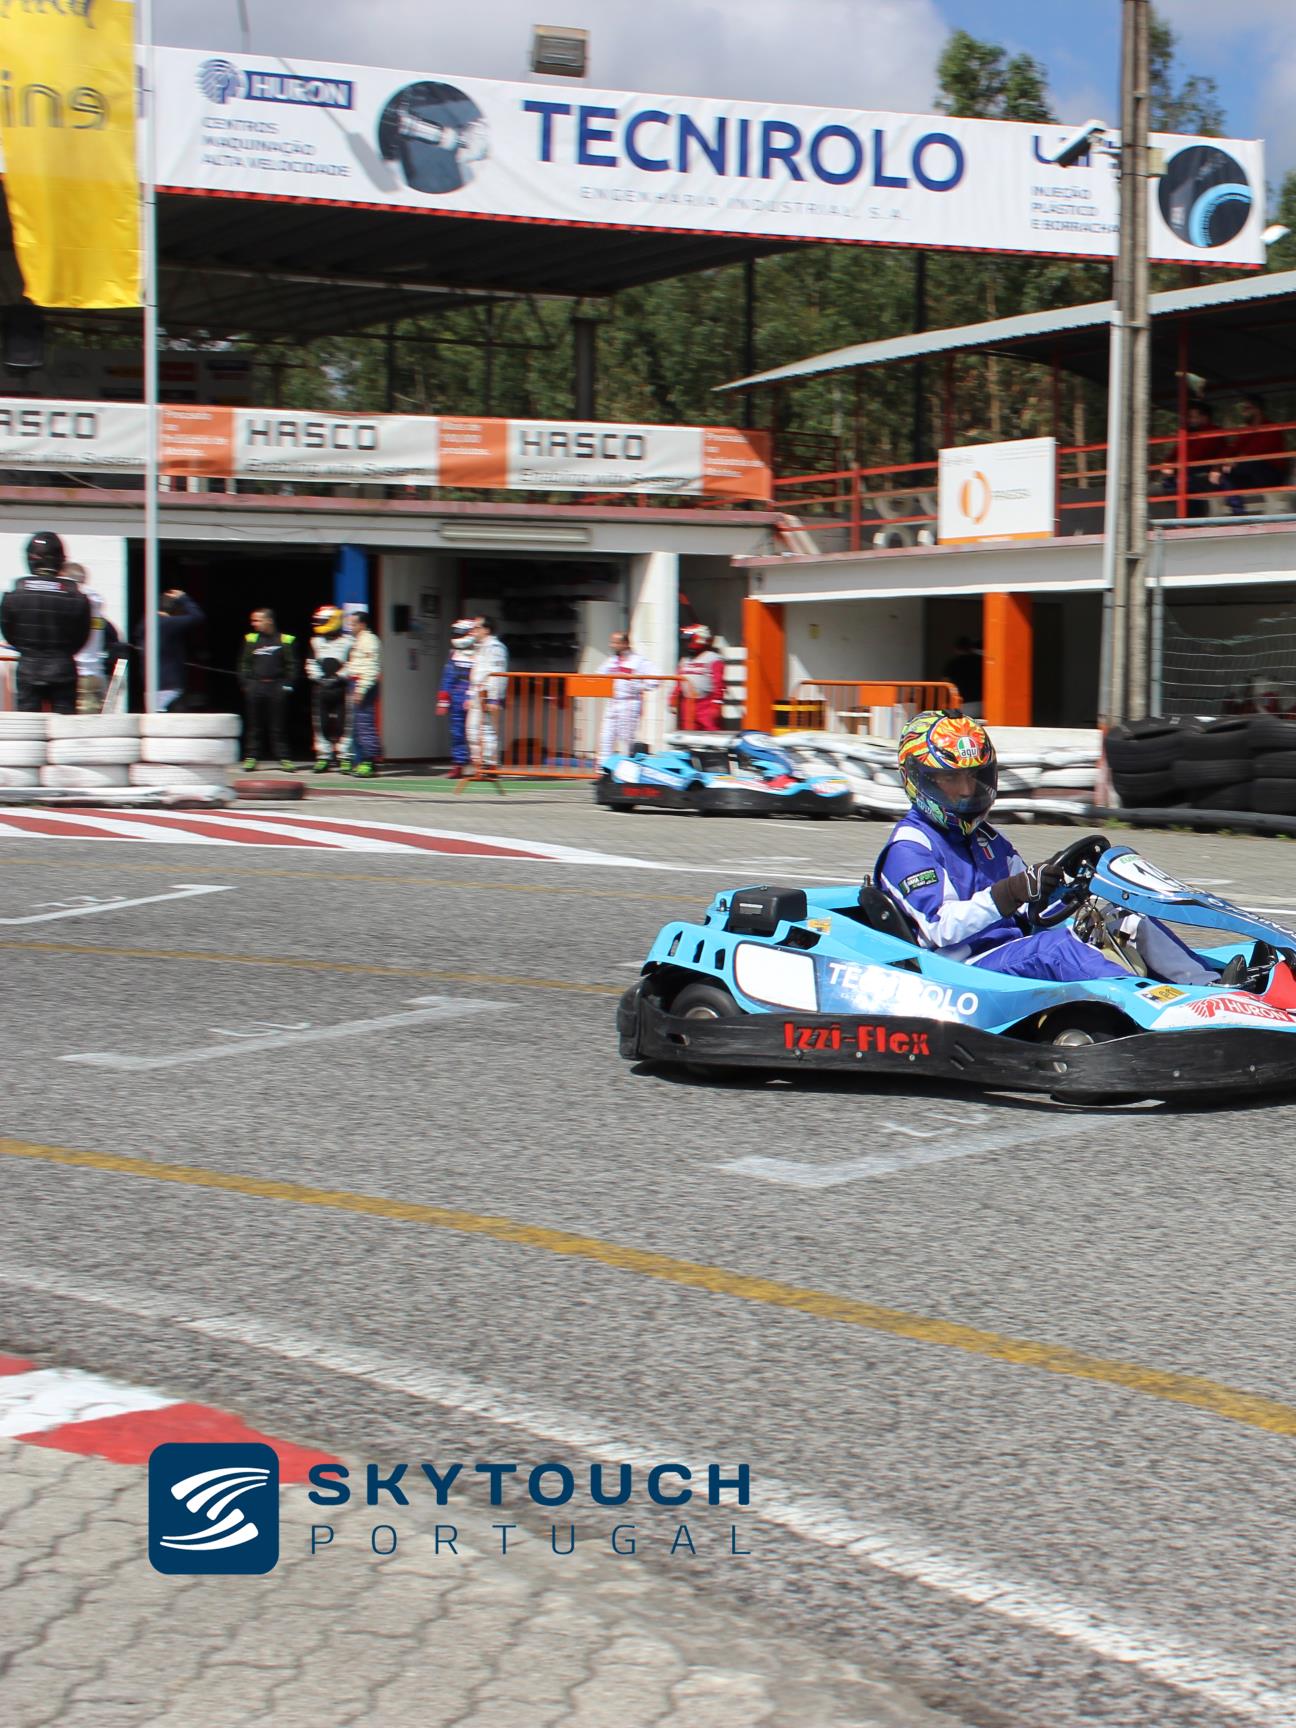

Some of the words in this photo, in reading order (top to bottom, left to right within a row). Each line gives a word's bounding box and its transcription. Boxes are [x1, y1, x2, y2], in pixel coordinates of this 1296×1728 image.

[250, 75, 350, 106] HURON
[202, 117, 280, 134] CENTROS
[523, 99, 965, 192] TECNIROLO
[202, 153, 246, 167] ALTA
[251, 156, 351, 177] VELOCIDADE
[579, 186, 719, 207] ENGENHARIA
[1031, 219, 1041, 230] E
[247, 419, 378, 451] HASCO
[519, 430, 646, 461] HASCO
[1228, 999, 1290, 1022] HURON
[783, 1022, 931, 1056] Izzi-Flex
